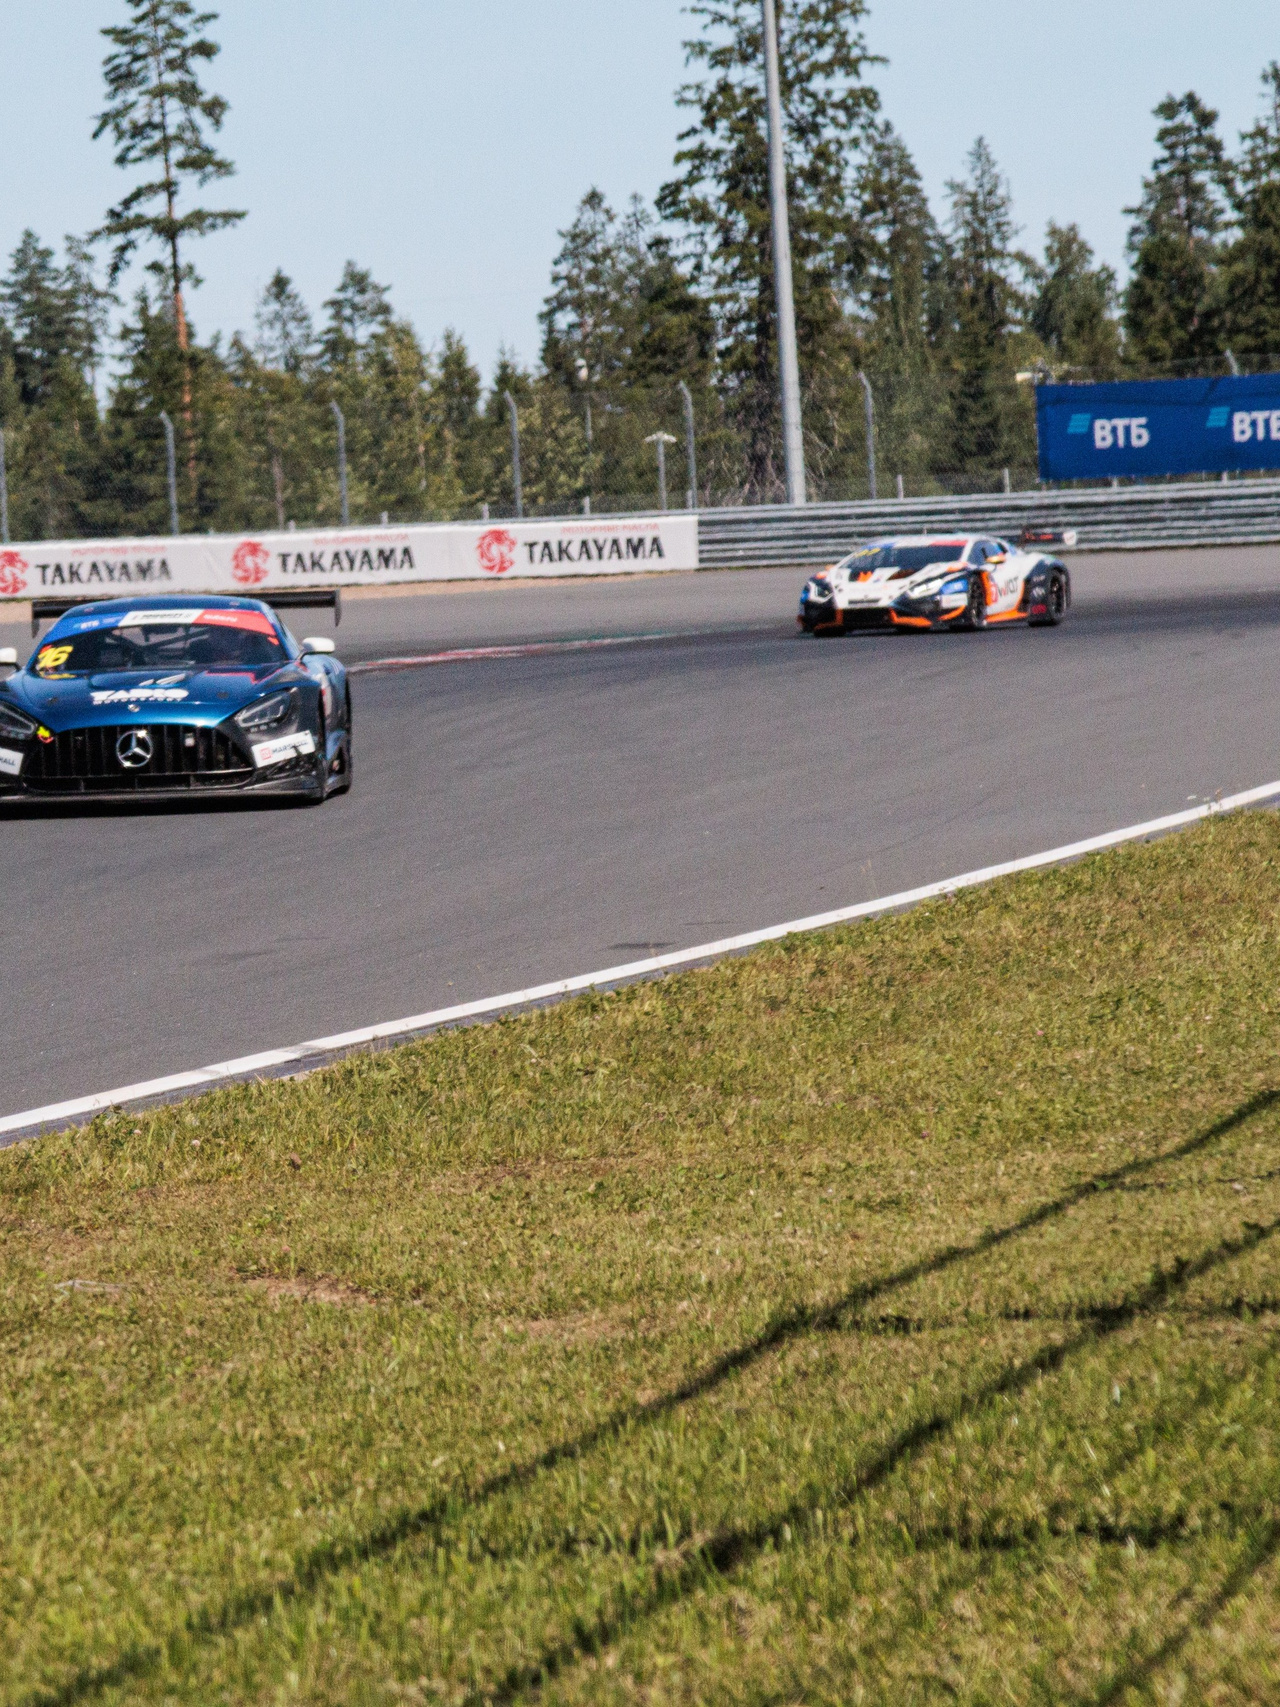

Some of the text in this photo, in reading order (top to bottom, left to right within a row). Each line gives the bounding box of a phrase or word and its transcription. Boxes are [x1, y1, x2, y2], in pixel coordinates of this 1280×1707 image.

[1093, 416, 1150, 449] ВТБ
[278, 546, 415, 573] TAKAYAMA
[524, 536, 665, 563] TAKAYAMA
[35, 558, 172, 585] TAKAYAMA
[37, 645, 74, 669] 16
